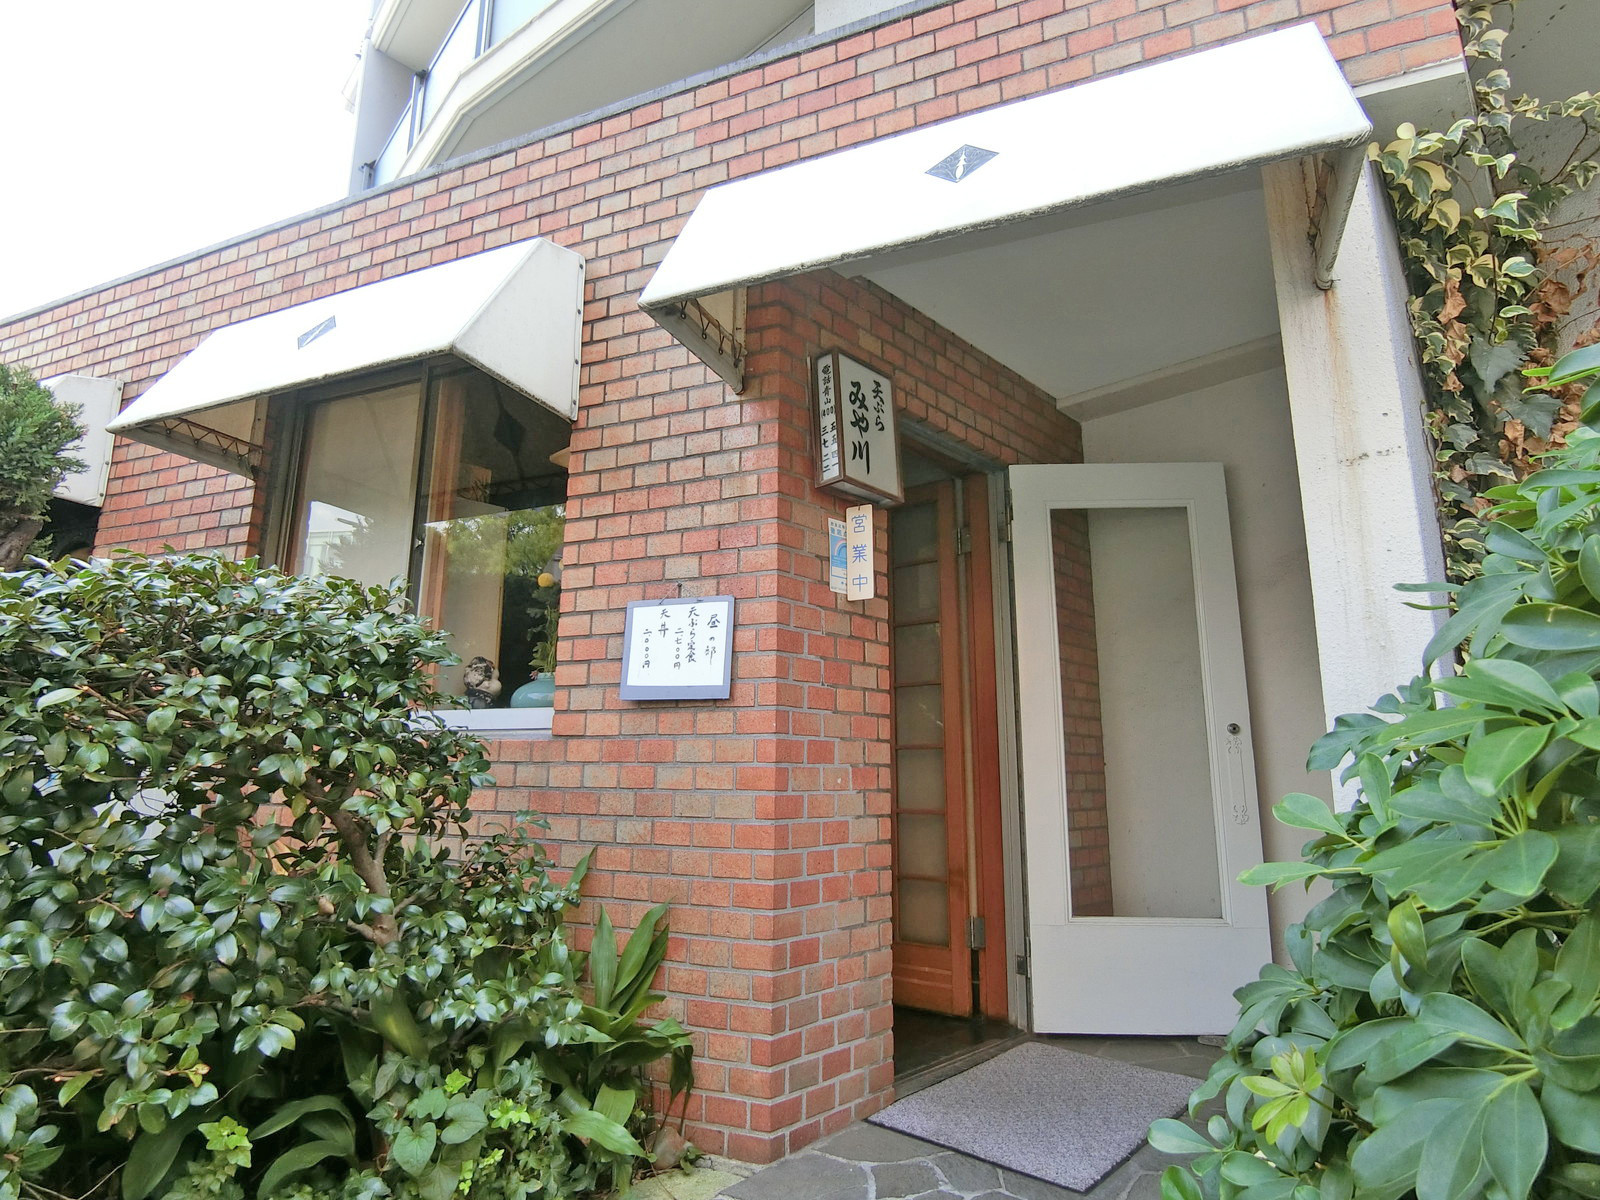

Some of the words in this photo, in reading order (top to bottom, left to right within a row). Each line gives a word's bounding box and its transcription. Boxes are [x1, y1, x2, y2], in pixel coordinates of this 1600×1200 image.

[849, 380, 870, 475] みや川
[872, 379, 885, 432] 天ぷら
[851, 513, 868, 593] 営業中
[685, 606, 700, 664] 天ぷら定食
[705, 613, 721, 666] 昼の部
